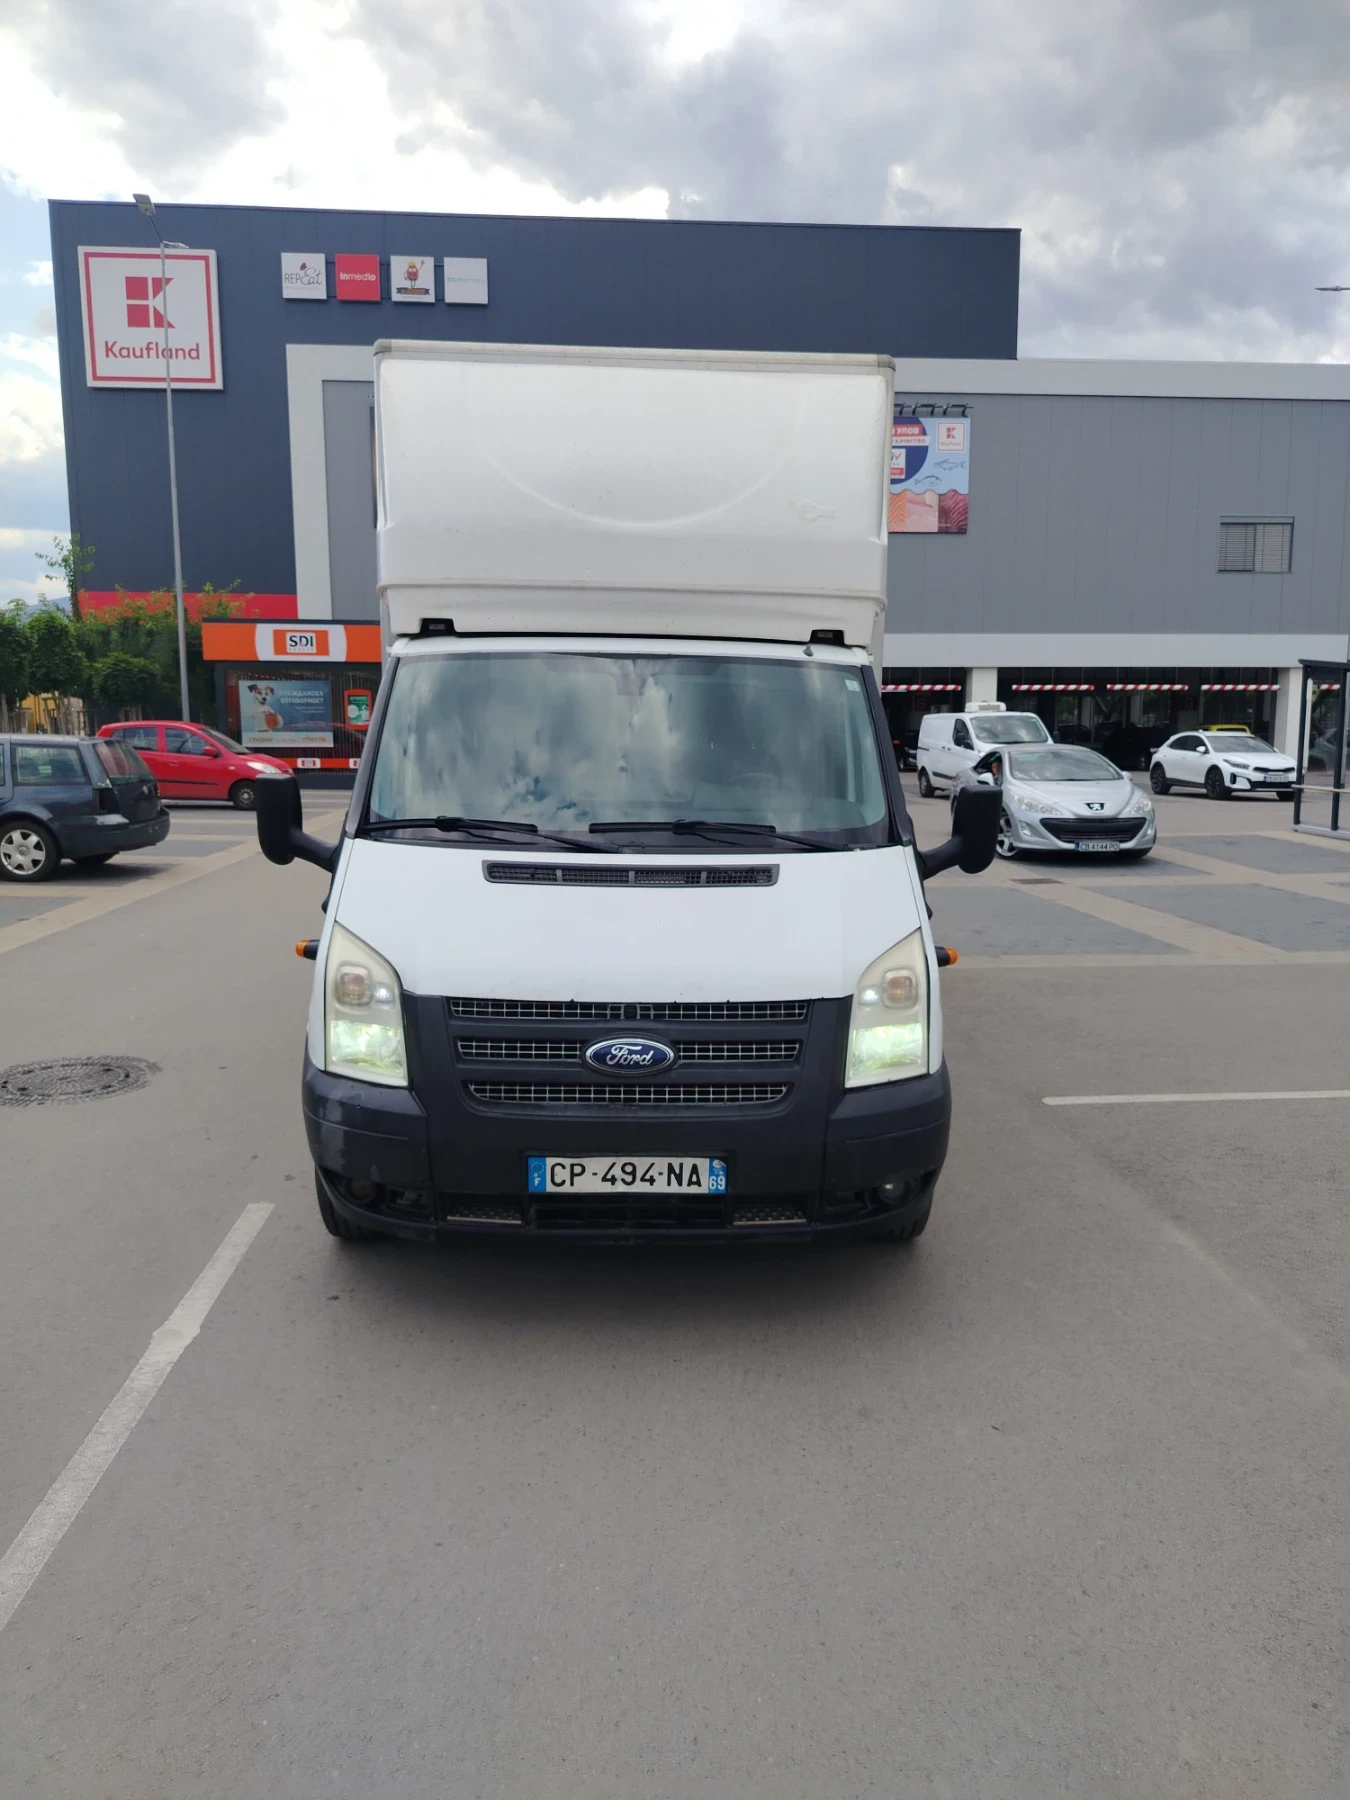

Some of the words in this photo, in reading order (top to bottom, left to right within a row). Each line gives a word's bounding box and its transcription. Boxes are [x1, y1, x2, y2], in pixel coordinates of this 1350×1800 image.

[104, 340, 201, 360] Kaufland
[289, 635, 314, 648] SDI
[606, 1044, 654, 1065] Ford
[534, 1178, 540, 1187] F
[550, 1161, 702, 1188] CP-494-NA
[709, 1175, 726, 1190] 69
